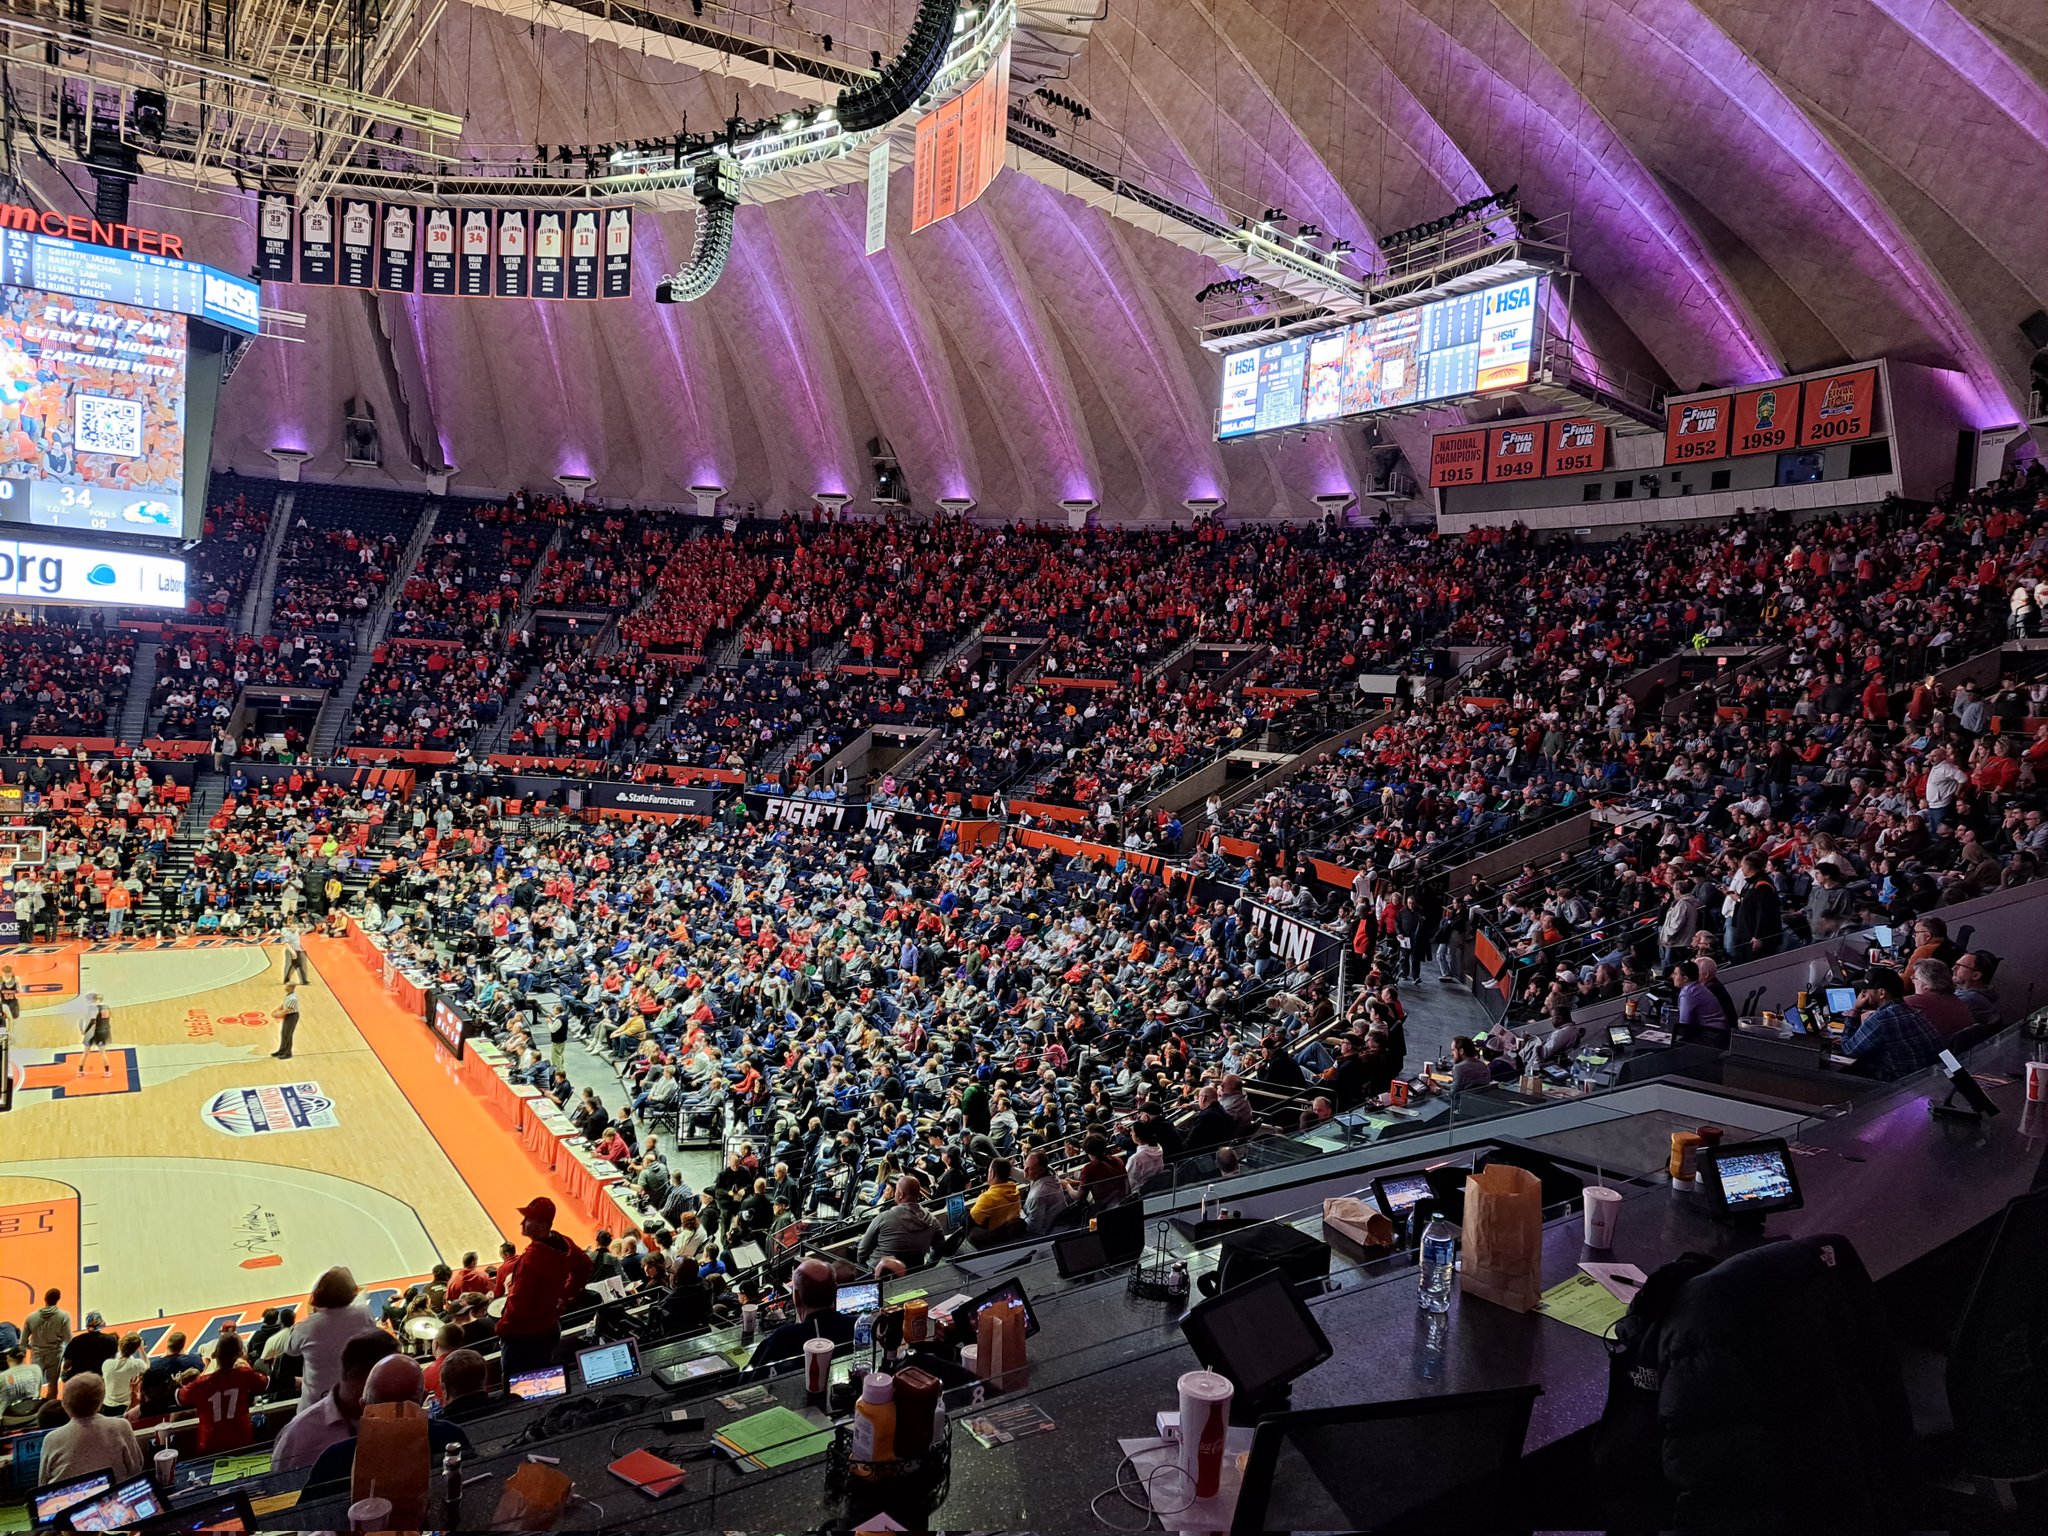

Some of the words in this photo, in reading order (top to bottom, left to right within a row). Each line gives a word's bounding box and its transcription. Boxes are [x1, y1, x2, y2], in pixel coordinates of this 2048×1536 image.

[41, 211, 184, 259] CENTER
[433, 231, 447, 241] 30
[469, 233, 483, 243] 34
[508, 234, 516, 244] 4
[545, 236, 551, 245] 5
[580, 235, 588, 245] 11
[615, 232, 621, 243] 11
[266, 247, 285, 255] BATTLE
[90, 256, 117, 266] JALEN
[168, 261, 184, 269] AST
[79, 268, 98, 279] SAM
[35, 280, 47, 288] 24
[48, 282, 77, 294] RUBIN,
[80, 287, 105, 298] MILES
[36, 272, 46, 280] 23
[48, 273, 77, 285] SPACE,
[80, 279, 112, 291] KAIDEN
[44, 306, 122, 331] EVERY
[125, 320, 170, 339] FAN
[25, 326, 82, 343] EVERY
[84, 336, 113, 348] BIG
[114, 340, 186, 360] MOMENT
[41, 350, 131, 371] CAPTURED
[132, 362, 176, 377] WITH
[1691, 408, 1717, 420] FINAL
[1569, 424, 1594, 434] FINAL
[1811, 418, 1861, 439] 2005
[1439, 438, 1477, 451] NATIONAL
[1509, 432, 1533, 442] FINAL
[1742, 430, 1785, 450] 1989
[1675, 440, 1717, 458] 1952
[1434, 450, 1481, 465] CHAMPIONS
[1556, 454, 1593, 471] 1951
[1439, 467, 1473, 482] 1915
[1496, 461, 1533, 477] 1949
[60, 487, 93, 508] 34
[90, 509, 117, 519] FOULS
[668, 798, 696, 806] CENTER
[259, 1087, 285, 1111] MADNESS
[265, 1110, 294, 1129] MARCH
[207, 1387, 239, 1423] 17
